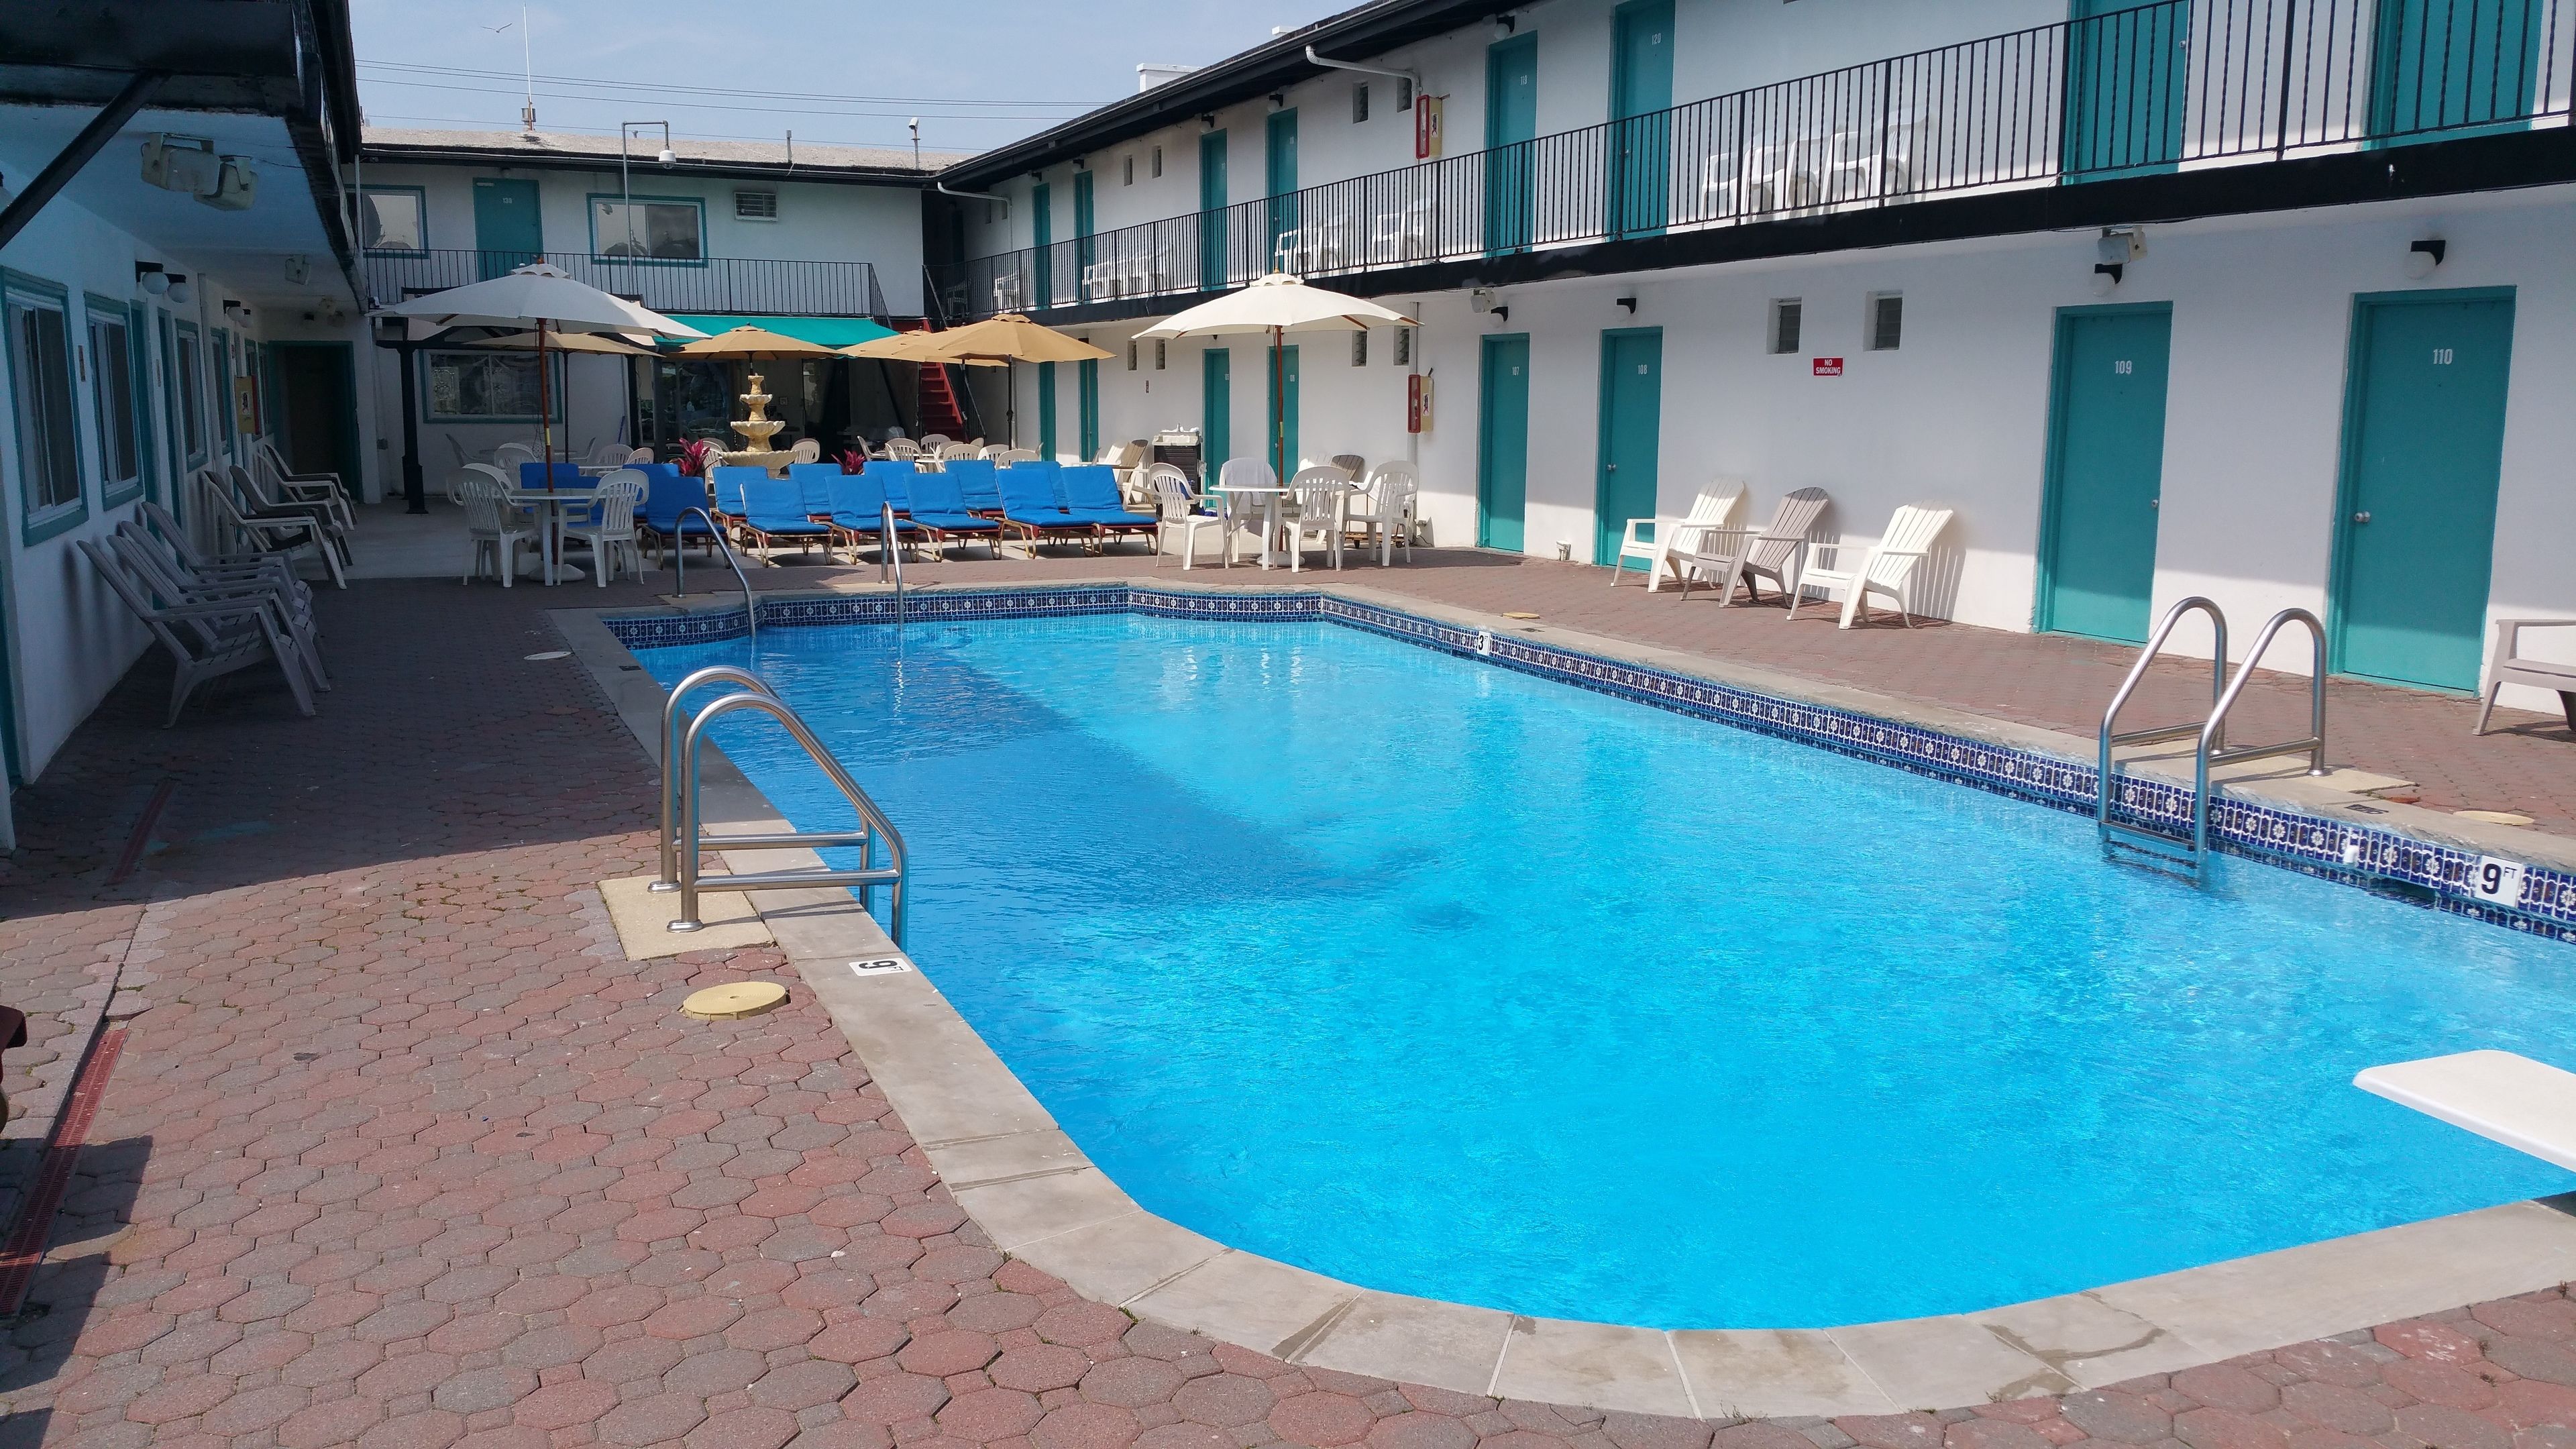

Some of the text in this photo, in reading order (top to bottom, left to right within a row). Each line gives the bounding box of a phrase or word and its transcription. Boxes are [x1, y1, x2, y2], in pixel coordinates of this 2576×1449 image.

[1652, 33, 1662, 46] 120
[2433, 348, 2453, 365] 110
[1638, 364, 1648, 375] 108
[2114, 360, 2133, 374] 109
[1479, 635, 1484, 651] 3
[2481, 863, 2517, 894] 9 FT
